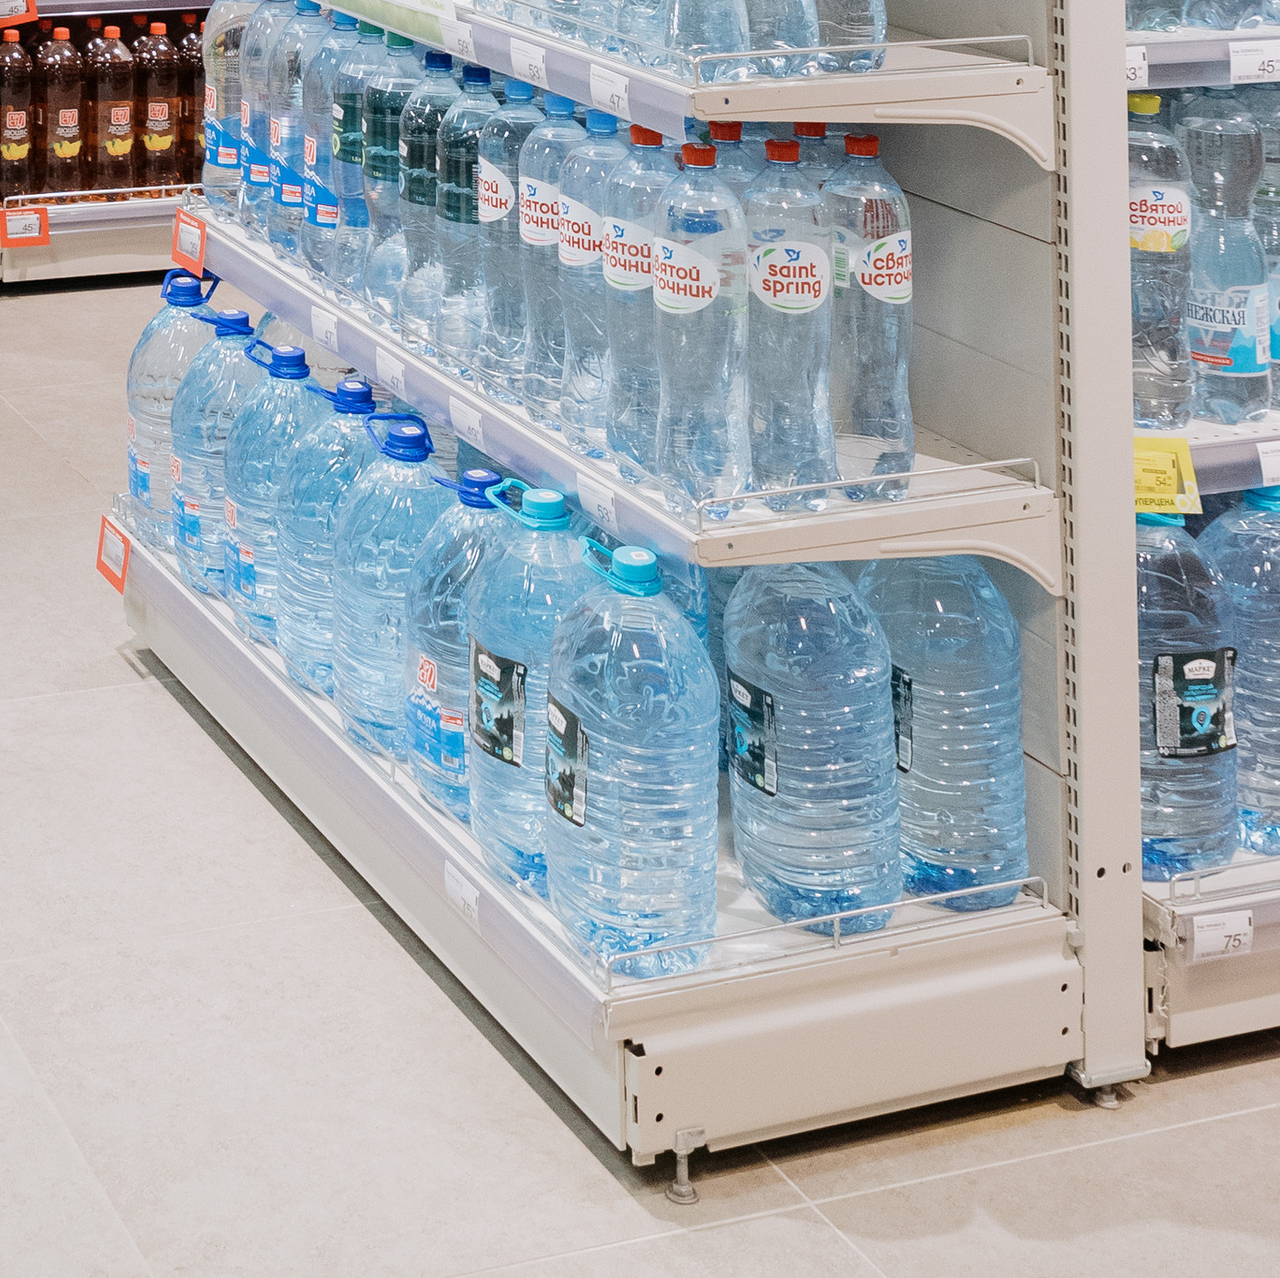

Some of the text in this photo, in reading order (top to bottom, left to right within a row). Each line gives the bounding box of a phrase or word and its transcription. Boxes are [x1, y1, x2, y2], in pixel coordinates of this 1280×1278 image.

[8, 5, 20, 14] 45
[458, 39, 469, 54] 59
[528, 64, 540, 79] 53
[1258, 60, 1274, 73] 45
[609, 93, 621, 111] 47
[1129, 200, 1182, 214] святой
[22, 223, 33, 232] 45
[768, 263, 816, 279] saint
[762, 279, 822, 298] spring
[1187, 303, 1247, 326] НЕЖСКАЯ
[597, 504, 610, 522] 53
[1223, 933, 1242, 950] 75
